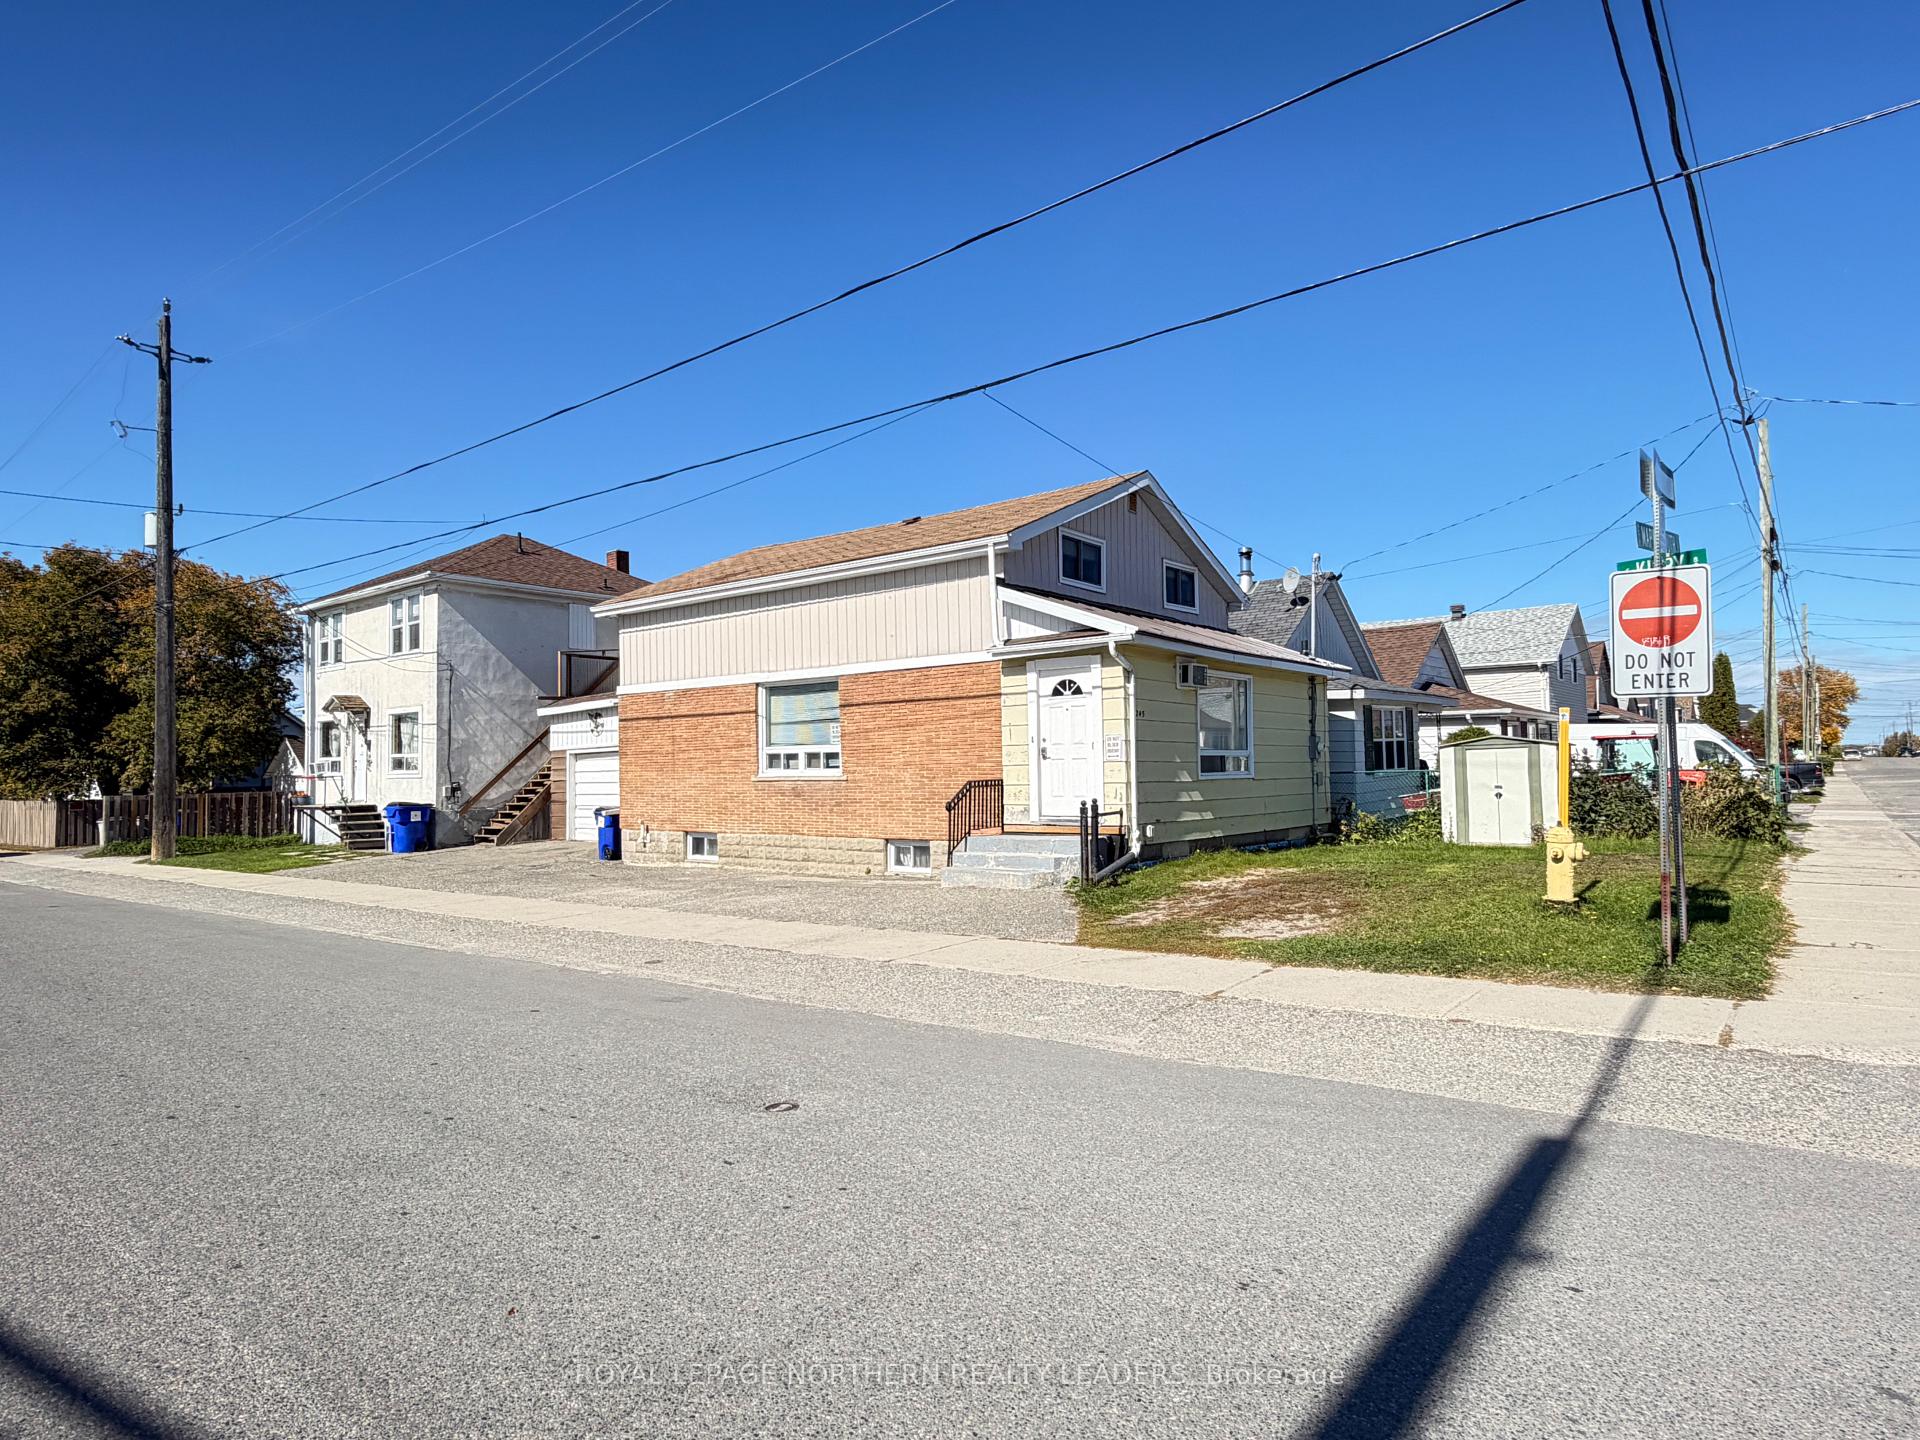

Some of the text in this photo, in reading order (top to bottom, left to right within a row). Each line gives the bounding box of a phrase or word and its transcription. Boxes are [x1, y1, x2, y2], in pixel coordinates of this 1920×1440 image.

[1636, 554, 1684, 570] KIBY
[1625, 651, 1696, 670] DO NOT
[1631, 672, 1690, 690] ENTER
